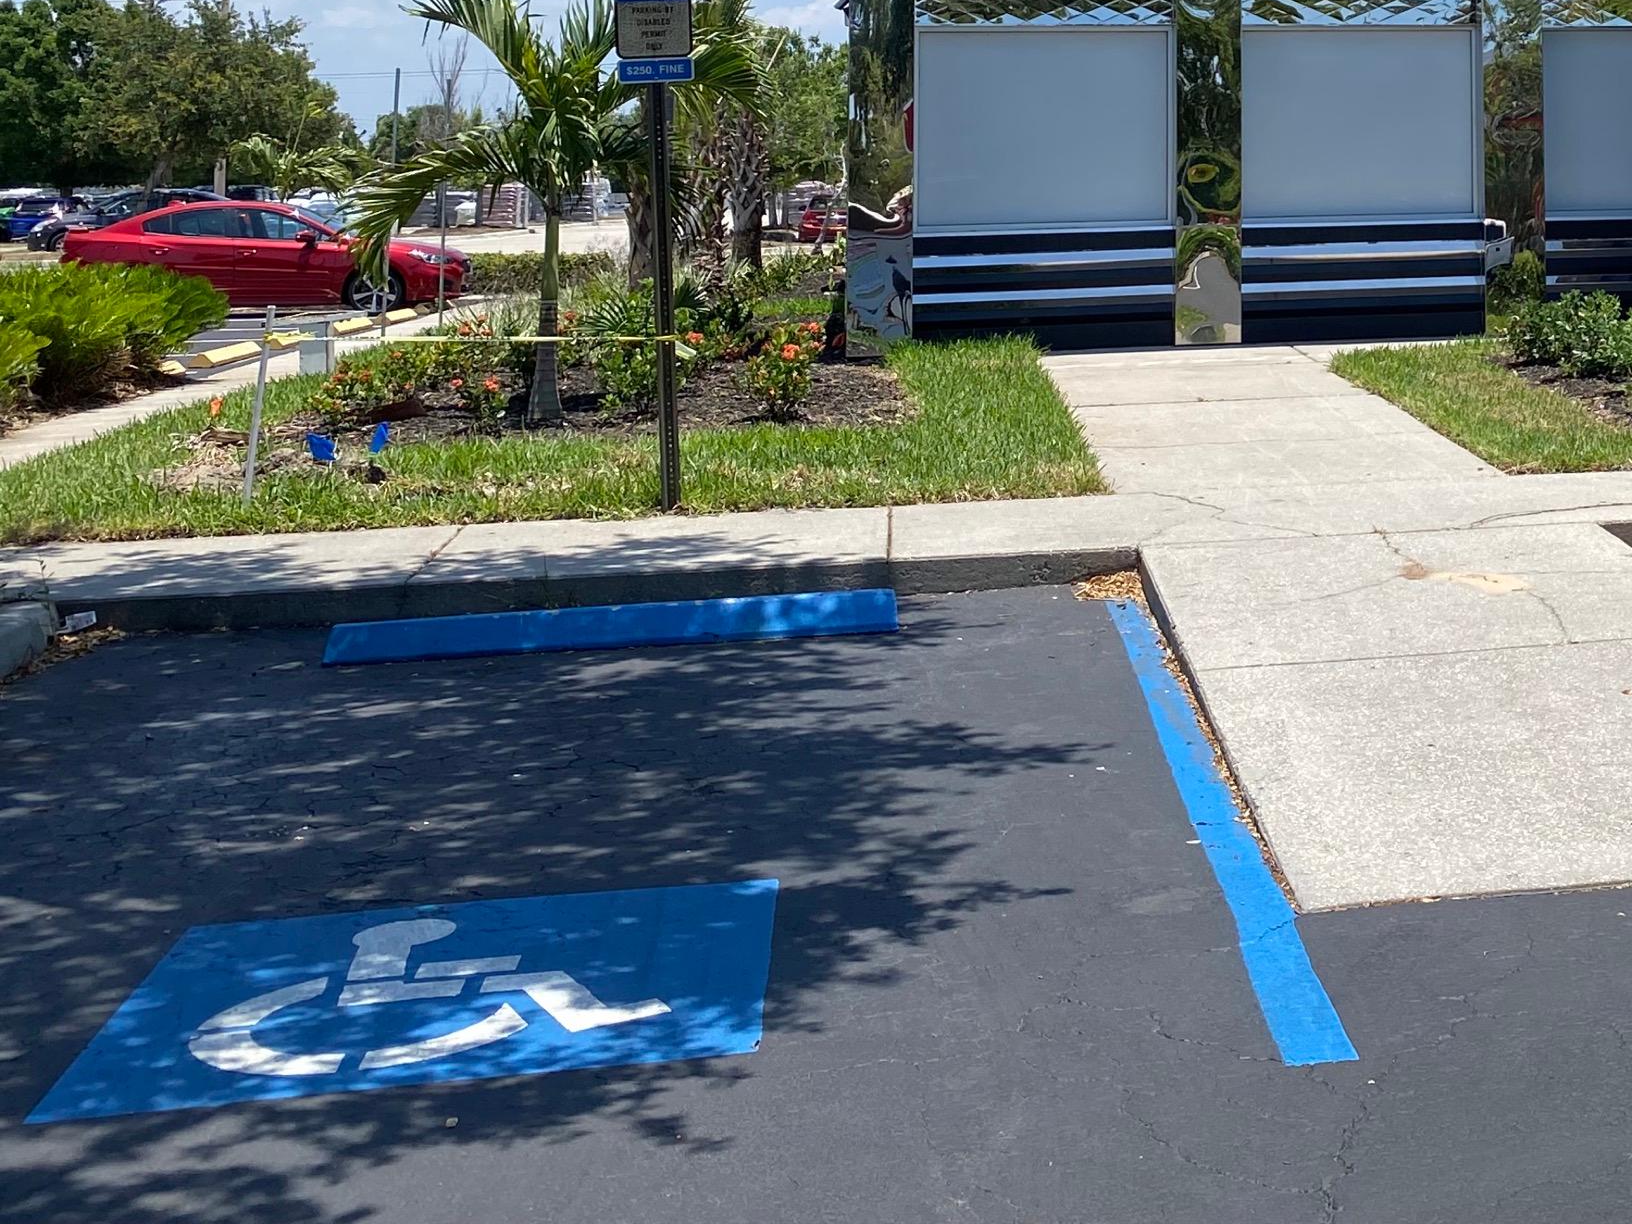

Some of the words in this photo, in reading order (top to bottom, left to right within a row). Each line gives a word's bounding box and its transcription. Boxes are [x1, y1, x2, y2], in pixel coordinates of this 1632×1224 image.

[641, 30, 666, 38] PERMIT
[645, 42, 663, 50] ONLY
[659, 64, 685, 74] FINE
